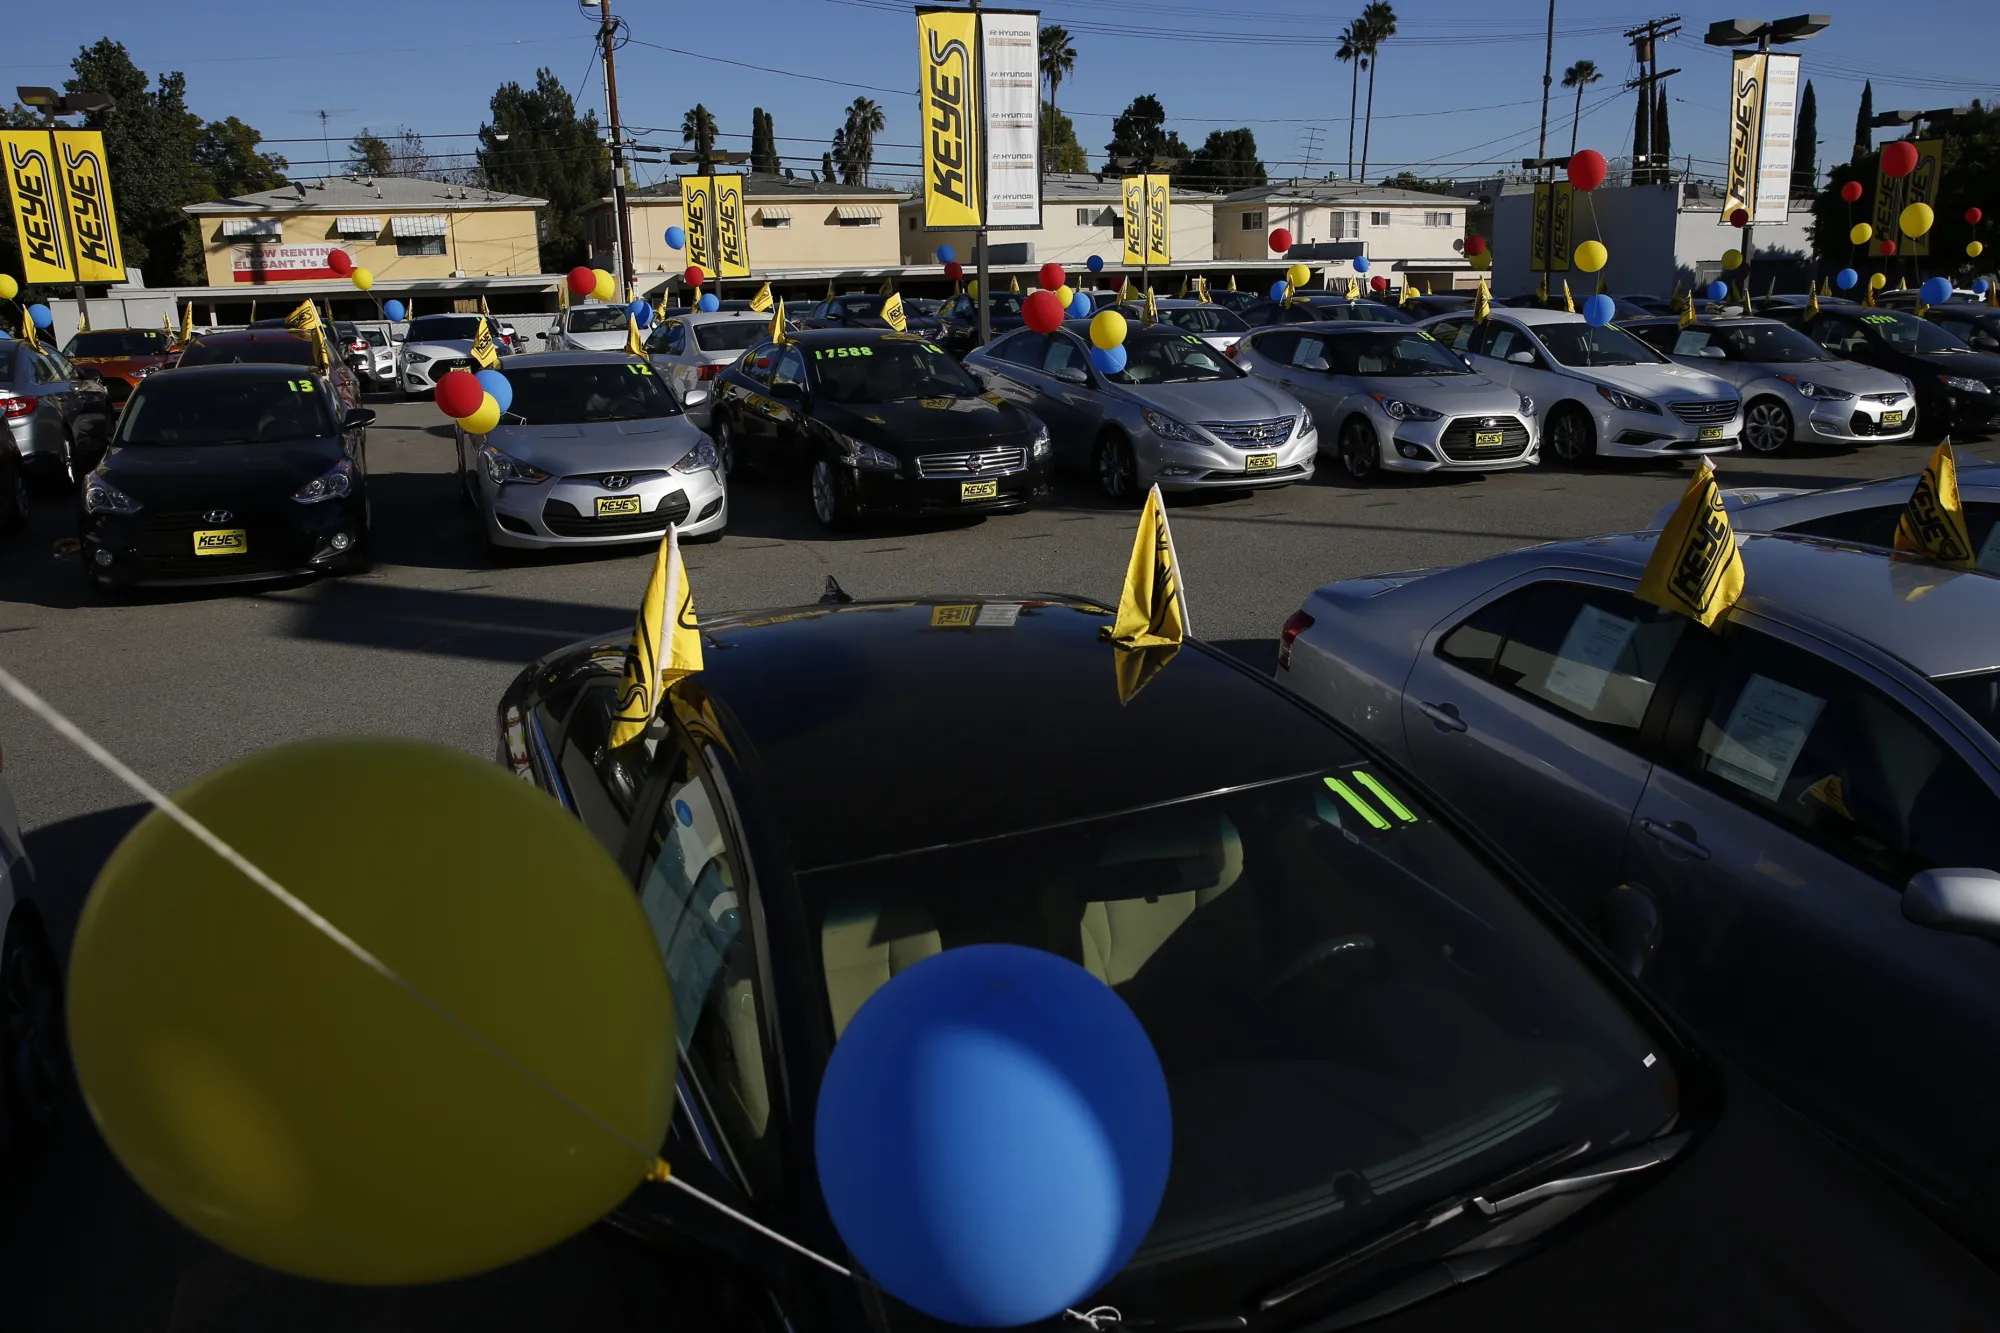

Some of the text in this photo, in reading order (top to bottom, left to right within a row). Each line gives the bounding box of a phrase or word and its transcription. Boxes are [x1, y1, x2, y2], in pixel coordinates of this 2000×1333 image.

[928, 28, 973, 209] KEYES
[1729, 68, 1759, 208] KEYES
[8, 142, 66, 270] KEYES
[62, 142, 117, 269] KEYES
[1875, 173, 1900, 243] KEYE
[686, 184, 713, 269] KEYES
[718, 184, 744, 268] KEYES
[1126, 181, 1143, 257] KEYES
[1150, 182, 1166, 257] KEYES
[1535, 191, 1549, 261] KEYES
[1552, 189, 1569, 263] KEYES
[245, 247, 338, 258] NOW RENTIN
[234, 260, 296, 270] ELEGANT
[1181, 335, 1203, 344] 12
[814, 346, 874, 360] 17588
[627, 363, 653, 376] 12
[287, 379, 314, 393] 13
[1883, 413, 1901, 423] KEYES
[1477, 433, 1501, 445] KEYES
[1701, 428, 1722, 438] KEYES
[1248, 456, 1276, 469] KEYES
[963, 483, 996, 498] KEYES
[600, 497, 638, 513] KEYES
[197, 533, 244, 550] KEYES
[1323, 770, 1419, 831] 11
